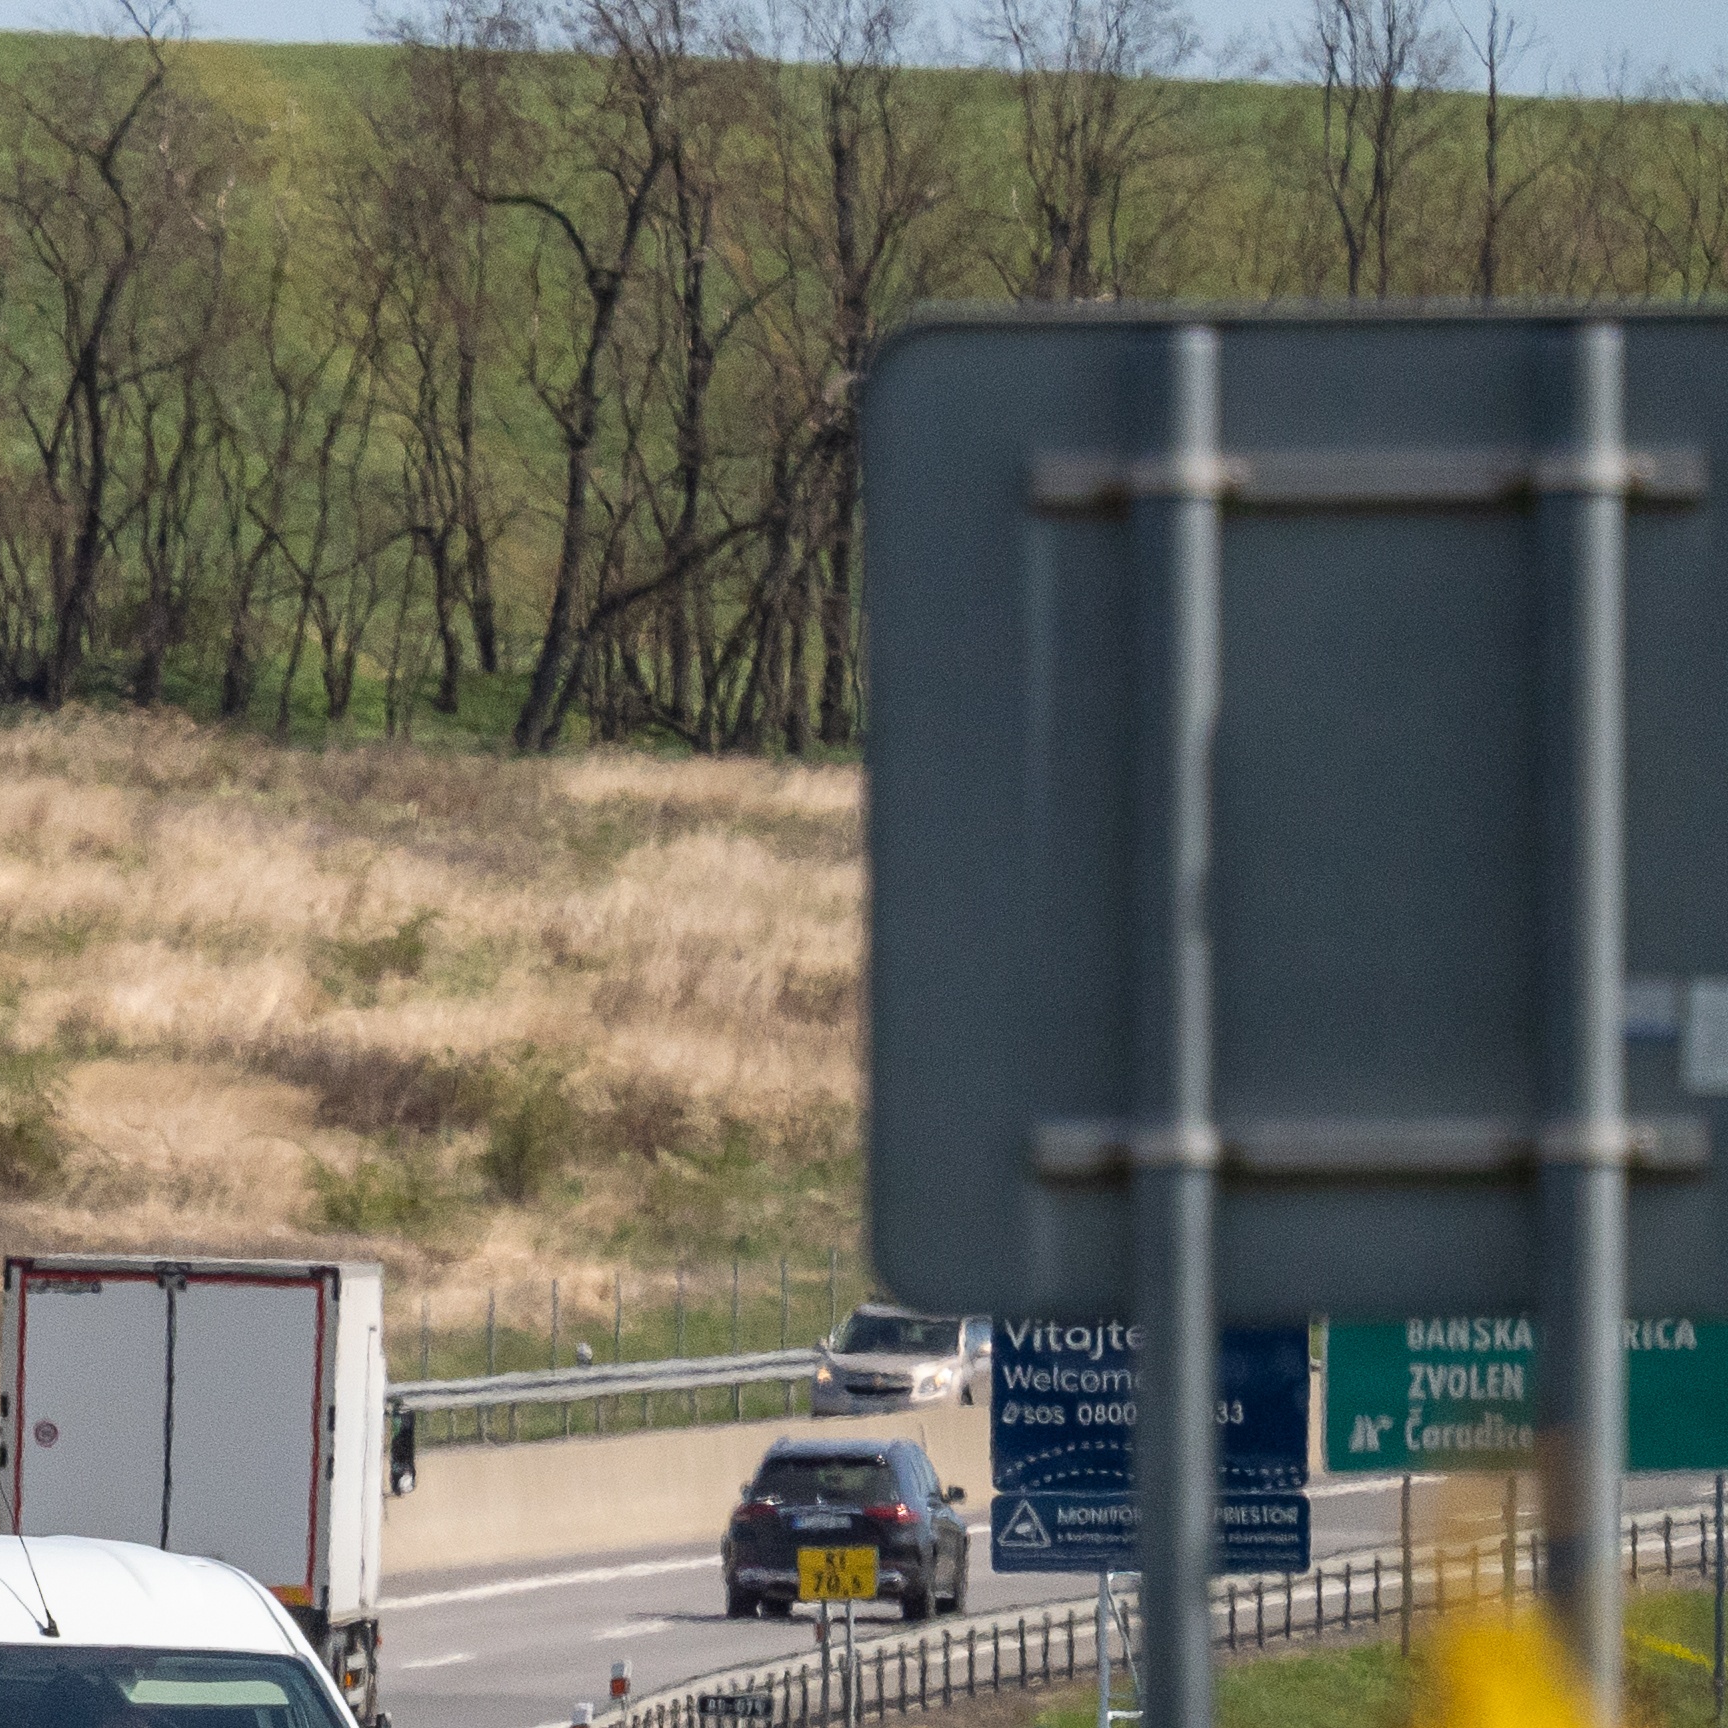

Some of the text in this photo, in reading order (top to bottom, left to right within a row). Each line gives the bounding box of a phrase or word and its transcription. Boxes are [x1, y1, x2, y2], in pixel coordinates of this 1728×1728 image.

[1002, 1364, 1141, 1393] Welcom
[1409, 1363, 1523, 1400] ZVOLEN
[1077, 1403, 1137, 1426] 0800
